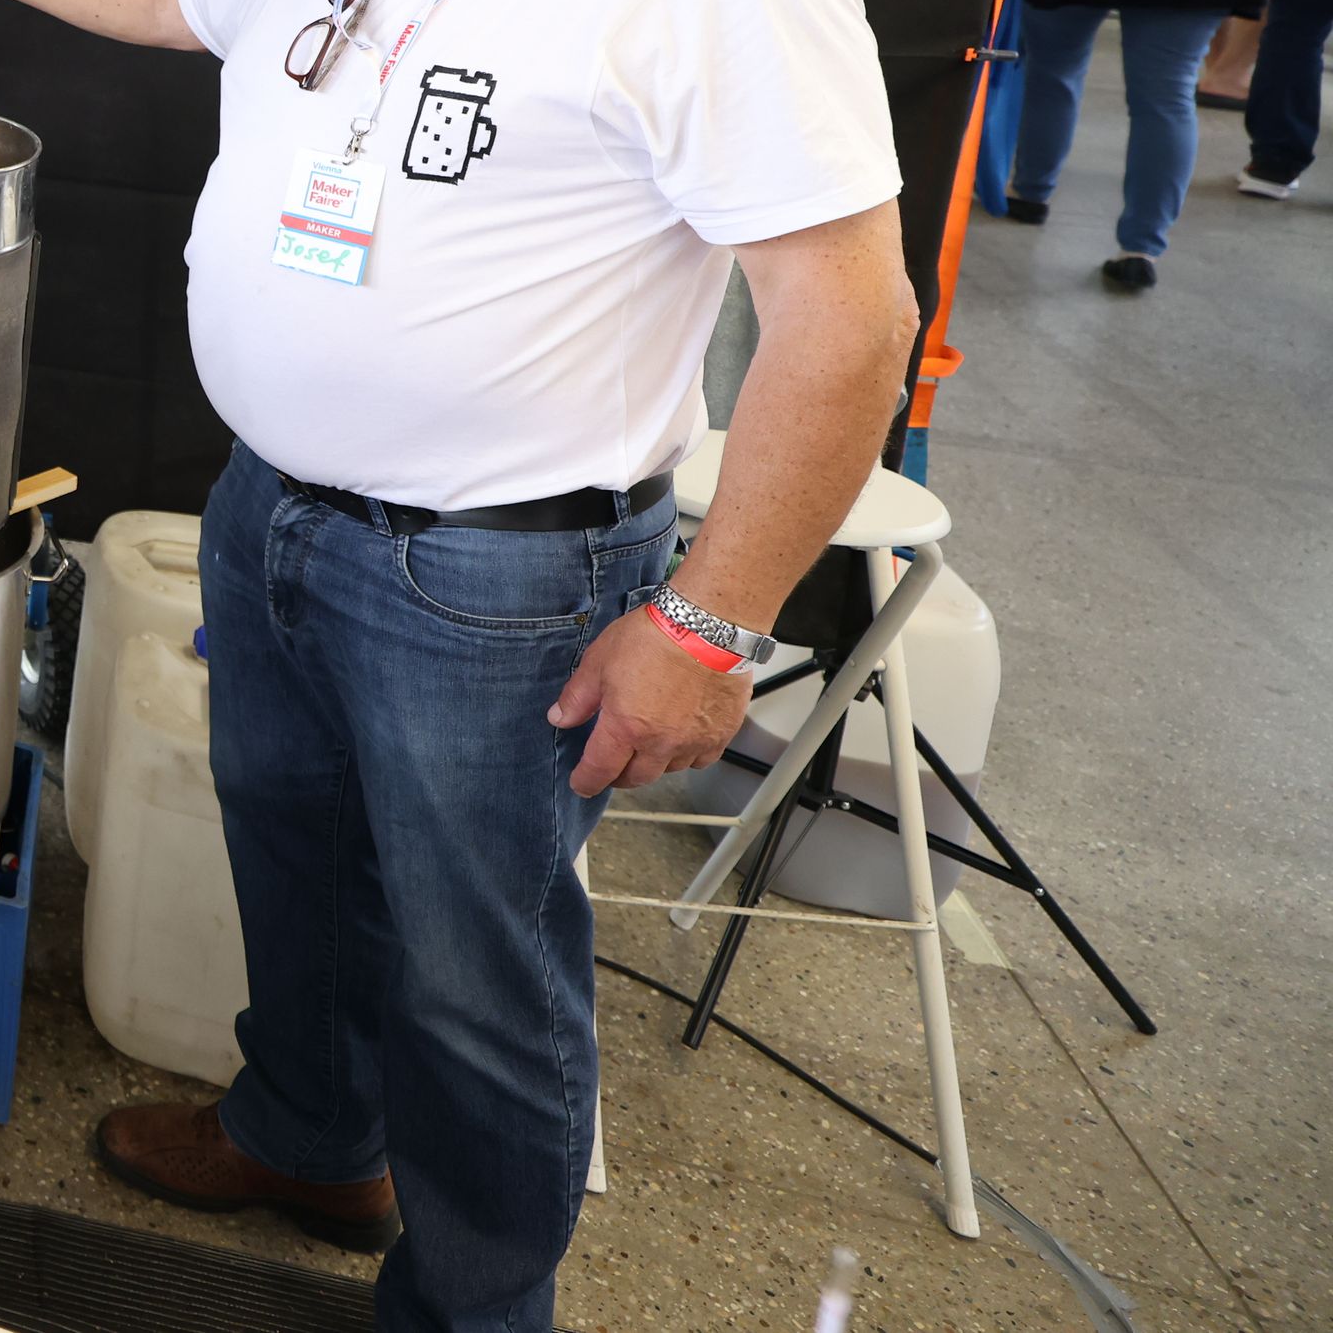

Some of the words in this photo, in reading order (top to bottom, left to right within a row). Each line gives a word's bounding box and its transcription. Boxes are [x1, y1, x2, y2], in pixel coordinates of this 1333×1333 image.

[391, 24, 415, 57] Maker
[312, 162, 342, 175] Vienna
[311, 179, 353, 198] Maker
[309, 191, 341, 209] Faire
[306, 222, 342, 239] MAKER
[282, 233, 351, 274] Josef
